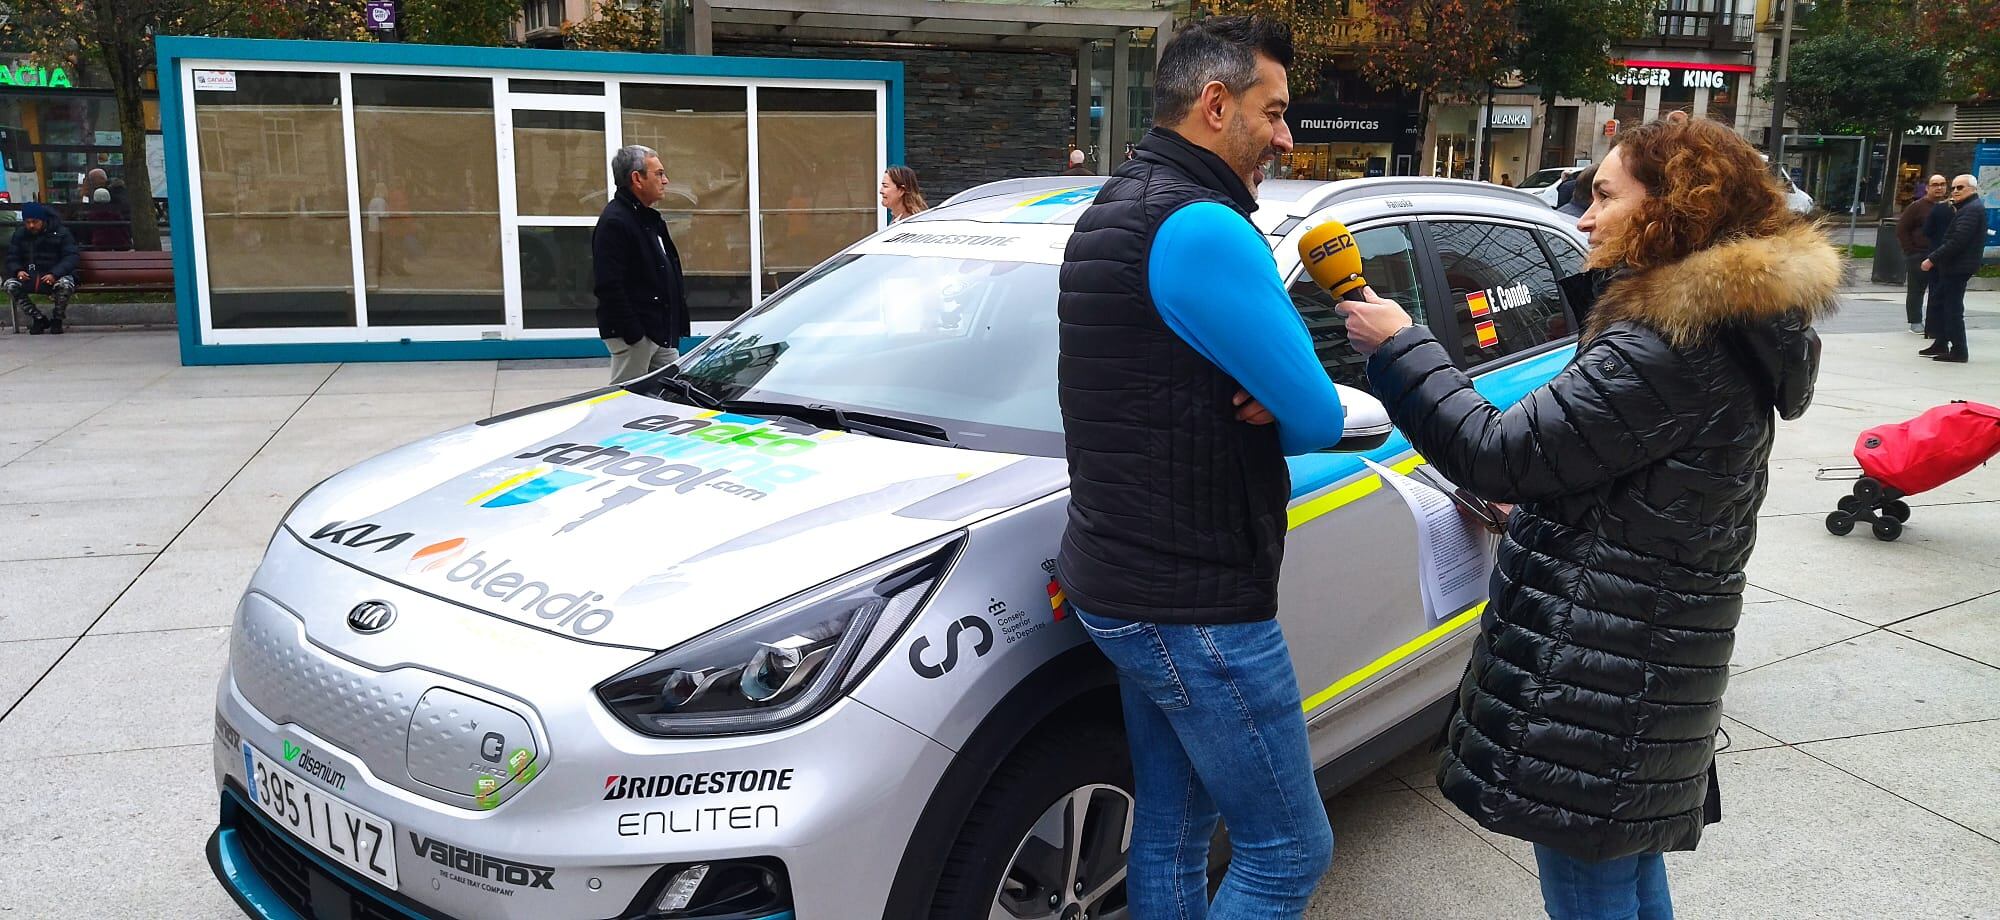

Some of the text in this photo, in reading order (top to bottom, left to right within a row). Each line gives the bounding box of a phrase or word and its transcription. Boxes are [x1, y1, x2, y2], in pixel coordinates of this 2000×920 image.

[1607, 68, 1724, 88] URGER KING
[1491, 114, 1527, 125] ULANKA
[883, 232, 1021, 247] BRIDGESTONE
[1309, 233, 1354, 265] SER
[1496, 282, 1531, 310] Conde
[622, 414, 818, 457] eneko
[446, 550, 614, 636] blendio
[349, 602, 388, 629] KIA
[998, 610, 1025, 626] Consejo
[1002, 618, 1031, 635] Superior
[1006, 622, 1046, 644] de Deportes
[298, 749, 346, 791] disenium
[603, 768, 794, 801] BRIDGESTONE
[257, 761, 387, 876] 3951 LYZ
[618, 805, 778, 836] ENLITEN
[408, 831, 555, 890] Valdinox
[440, 869, 515, 897] THE CABLE TRAY COMPANY
